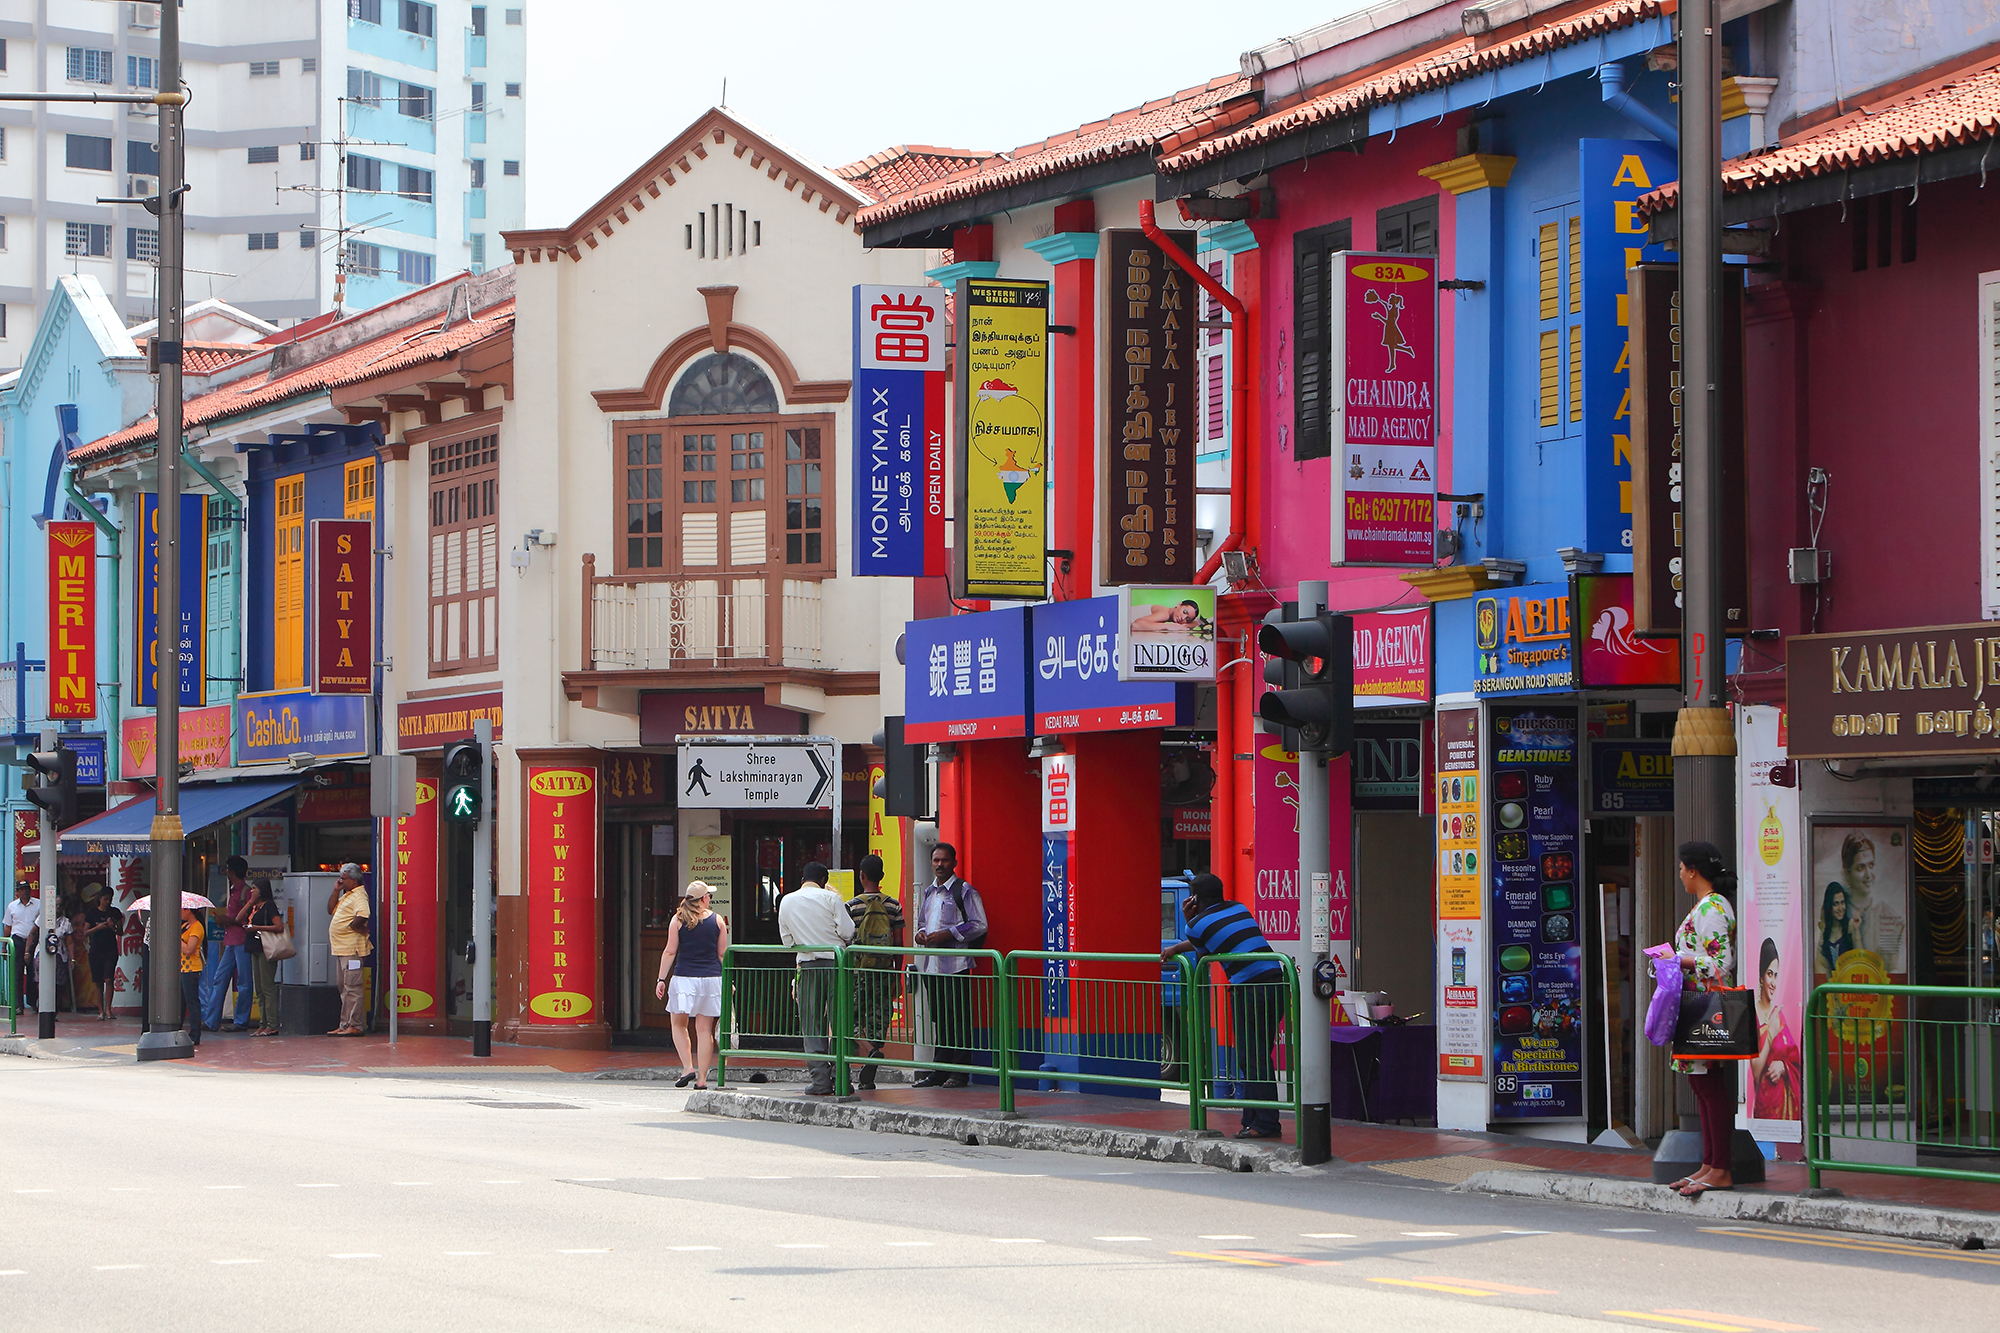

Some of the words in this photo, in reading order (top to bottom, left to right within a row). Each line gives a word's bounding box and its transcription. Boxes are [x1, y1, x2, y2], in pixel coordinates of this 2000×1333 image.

[1374, 266, 1406, 281] 83A
[972, 288, 1015, 297] WESTERN
[985, 296, 1015, 304] UNION
[870, 293, 935, 363] 當
[1347, 378, 1431, 410] CHAINDRA
[1348, 416, 1378, 439] MAID
[1381, 414, 1431, 441] AGENCY
[929, 430, 942, 470] DAILY
[871, 387, 889, 559] MONEYMAX
[1159, 382, 1182, 566] JEWELLERS
[929, 472, 941, 516] OPEN
[1347, 497, 1368, 521] Tel:
[1372, 498, 1401, 521] 6297
[1403, 499, 1432, 523] 7172
[1347, 526, 1432, 546] www.chaindramaid.com.sg
[336, 534, 354, 668] SATYA
[1727, 608, 1740, 620] 87
[58, 555, 86, 700] MERLIN
[1375, 614, 1428, 668] AGENCY
[1134, 643, 1207, 668] INDIGO
[1507, 643, 1567, 668] Singapore's
[1692, 633, 1705, 701] D17
[1831, 639, 1968, 694] KAMALA
[321, 676, 367, 685] JEWELLERY
[1482, 675, 1524, 692] SERANGOON
[1526, 673, 1545, 689] ROAD
[54, 703, 72, 715] No.
[74, 703, 91, 714] 75
[400, 716, 422, 737] SATYA
[424, 710, 468, 735] JEWELLERY
[684, 705, 755, 732] SATYA
[1045, 715, 1060, 729] KEDAI
[1062, 714, 1080, 728] PAJAK
[1517, 718, 1575, 730] DICKSON
[1832, 712, 1900, 737] கமலா
[246, 707, 302, 748] Cash&Co.
[948, 723, 978, 737] PAWNSHOP
[746, 753, 776, 766] Shree
[1467, 750, 1475, 759] OF
[1497, 748, 1572, 763] GEMSTONES
[1444, 761, 1475, 771] GEMSTONES
[534, 776, 588, 791] SATYA
[719, 770, 803, 785] Lakshminarayan
[1534, 775, 1554, 785] Ruby
[744, 788, 779, 802] Temple
[1601, 792, 1625, 809] 85
[1533, 806, 1554, 815] Pearl
[1531, 833, 1549, 841] Yellow
[1550, 833, 1574, 842] Sapphire
[694, 856, 727, 864] Singapore
[1502, 864, 1537, 872] Hessonite
[552, 802, 570, 989] JEWELLERY
[1505, 891, 1537, 900] Emerald
[1258, 910, 1290, 934] MAID
[1507, 920, 1537, 928] DIAMOND
[1539, 952, 1553, 960] Cats
[1554, 952, 1566, 961] Eye
[1538, 981, 1550, 989] Blue
[1550, 981, 1574, 991] Sapphire
[552, 999, 572, 1013] 79
[1539, 1008, 1558, 1017] Coral
[1520, 1038, 1536, 1048] We
[1536, 1039, 1558, 1048] are
[1513, 1049, 1565, 1060] Specialist
[1501, 1062, 1515, 1072] In
[1516, 1061, 1578, 1073] Birthstones
[1497, 1078, 1516, 1091] 85
[1512, 1099, 1566, 1107] www.ajs.com.sg
